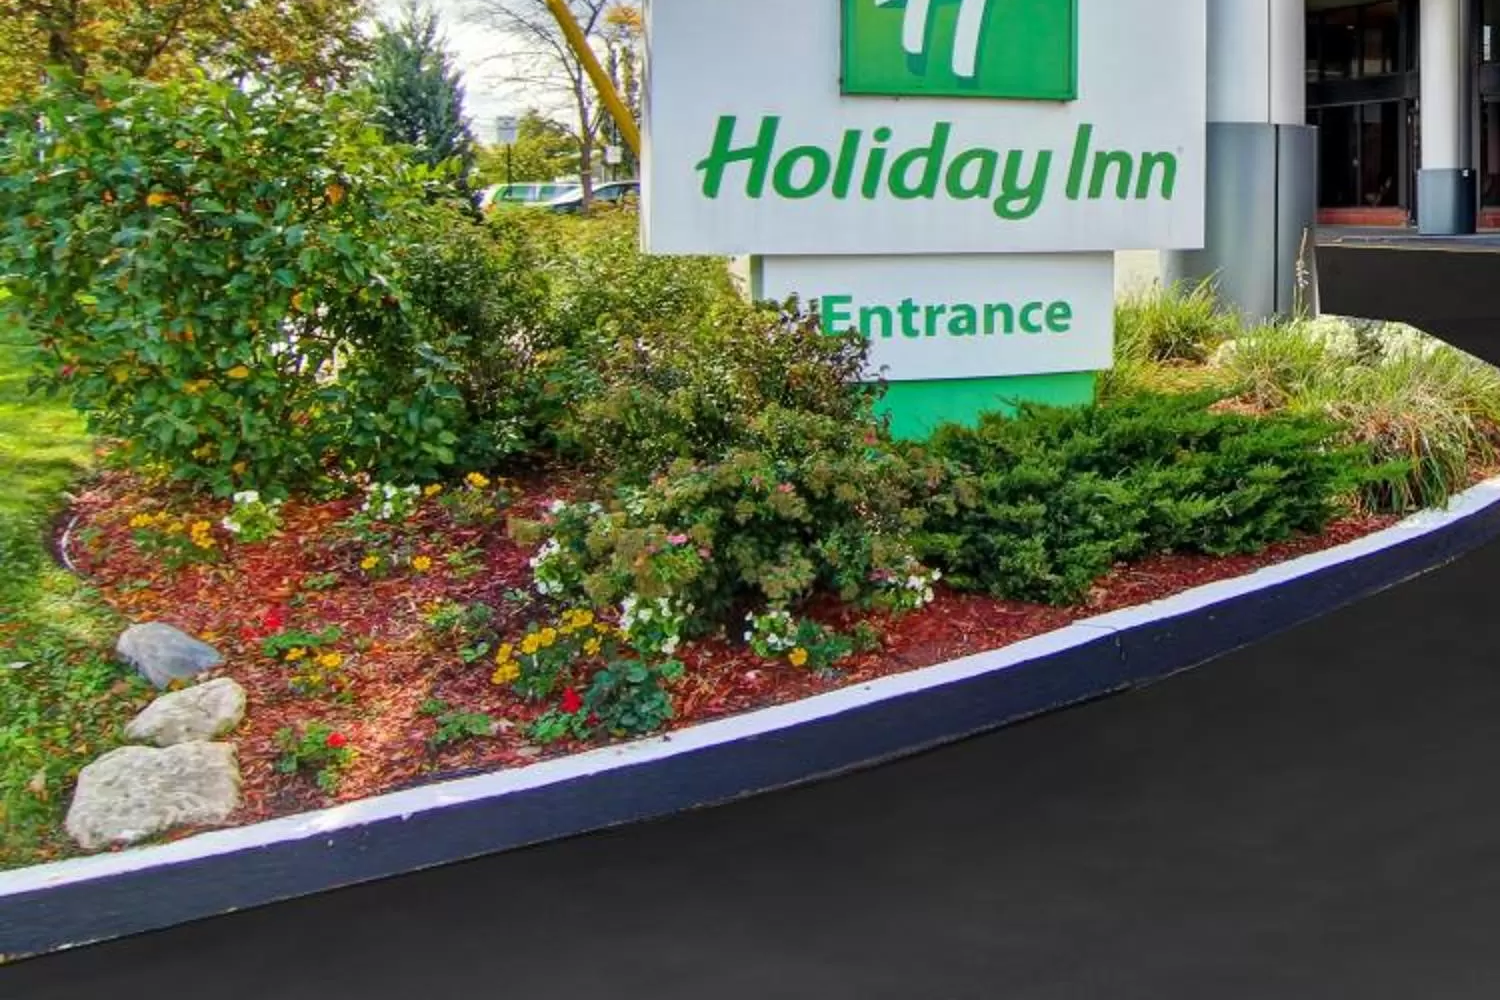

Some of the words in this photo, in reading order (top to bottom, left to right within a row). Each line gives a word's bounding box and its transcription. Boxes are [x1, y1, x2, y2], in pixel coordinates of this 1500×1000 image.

[696, 114, 1052, 220] Holiday
[1065, 123, 1178, 200] Inn
[820, 294, 1073, 338] Entrance
